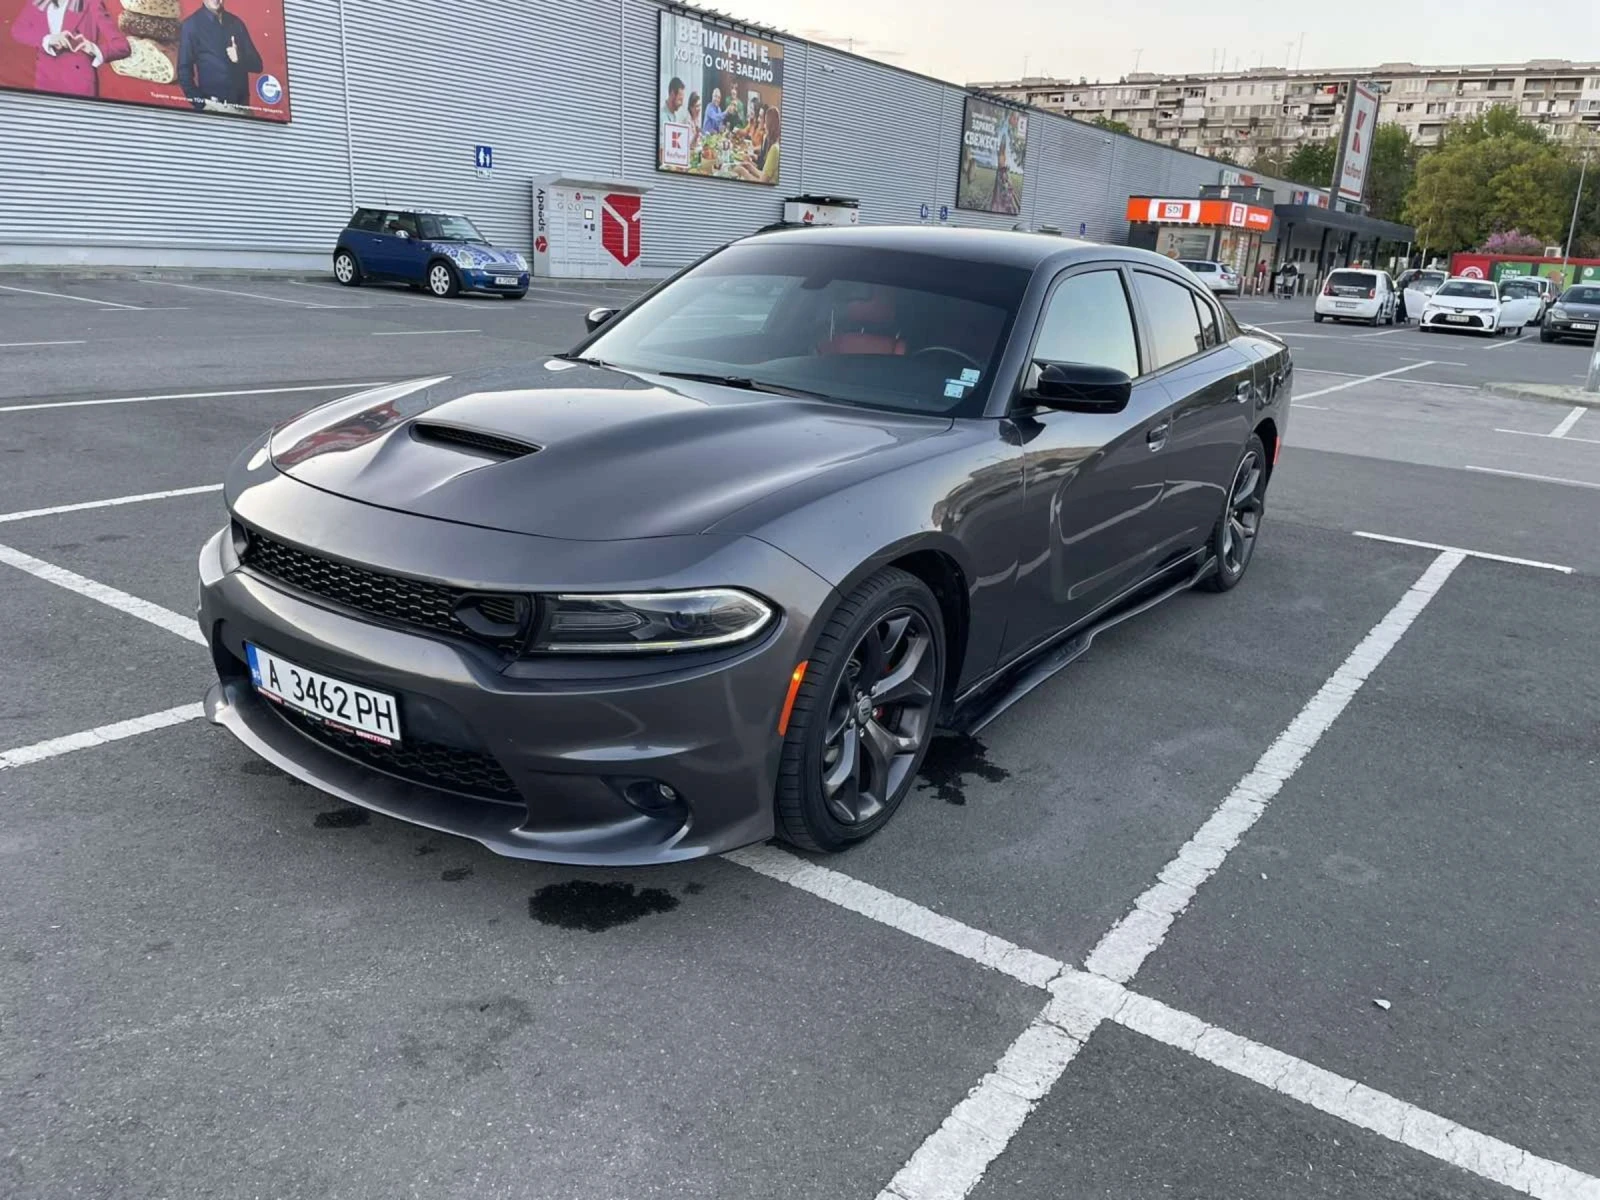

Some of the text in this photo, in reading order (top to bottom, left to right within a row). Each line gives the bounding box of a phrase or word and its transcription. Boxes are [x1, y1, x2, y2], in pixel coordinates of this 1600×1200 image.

[679, 22, 757, 61] ВЕЛИКДЕН
[674, 47, 773, 82] КОГАТО СМЕ ЗАЕДНО
[536, 188, 546, 232] speedy
[269, 659, 394, 734] A 3462PH
